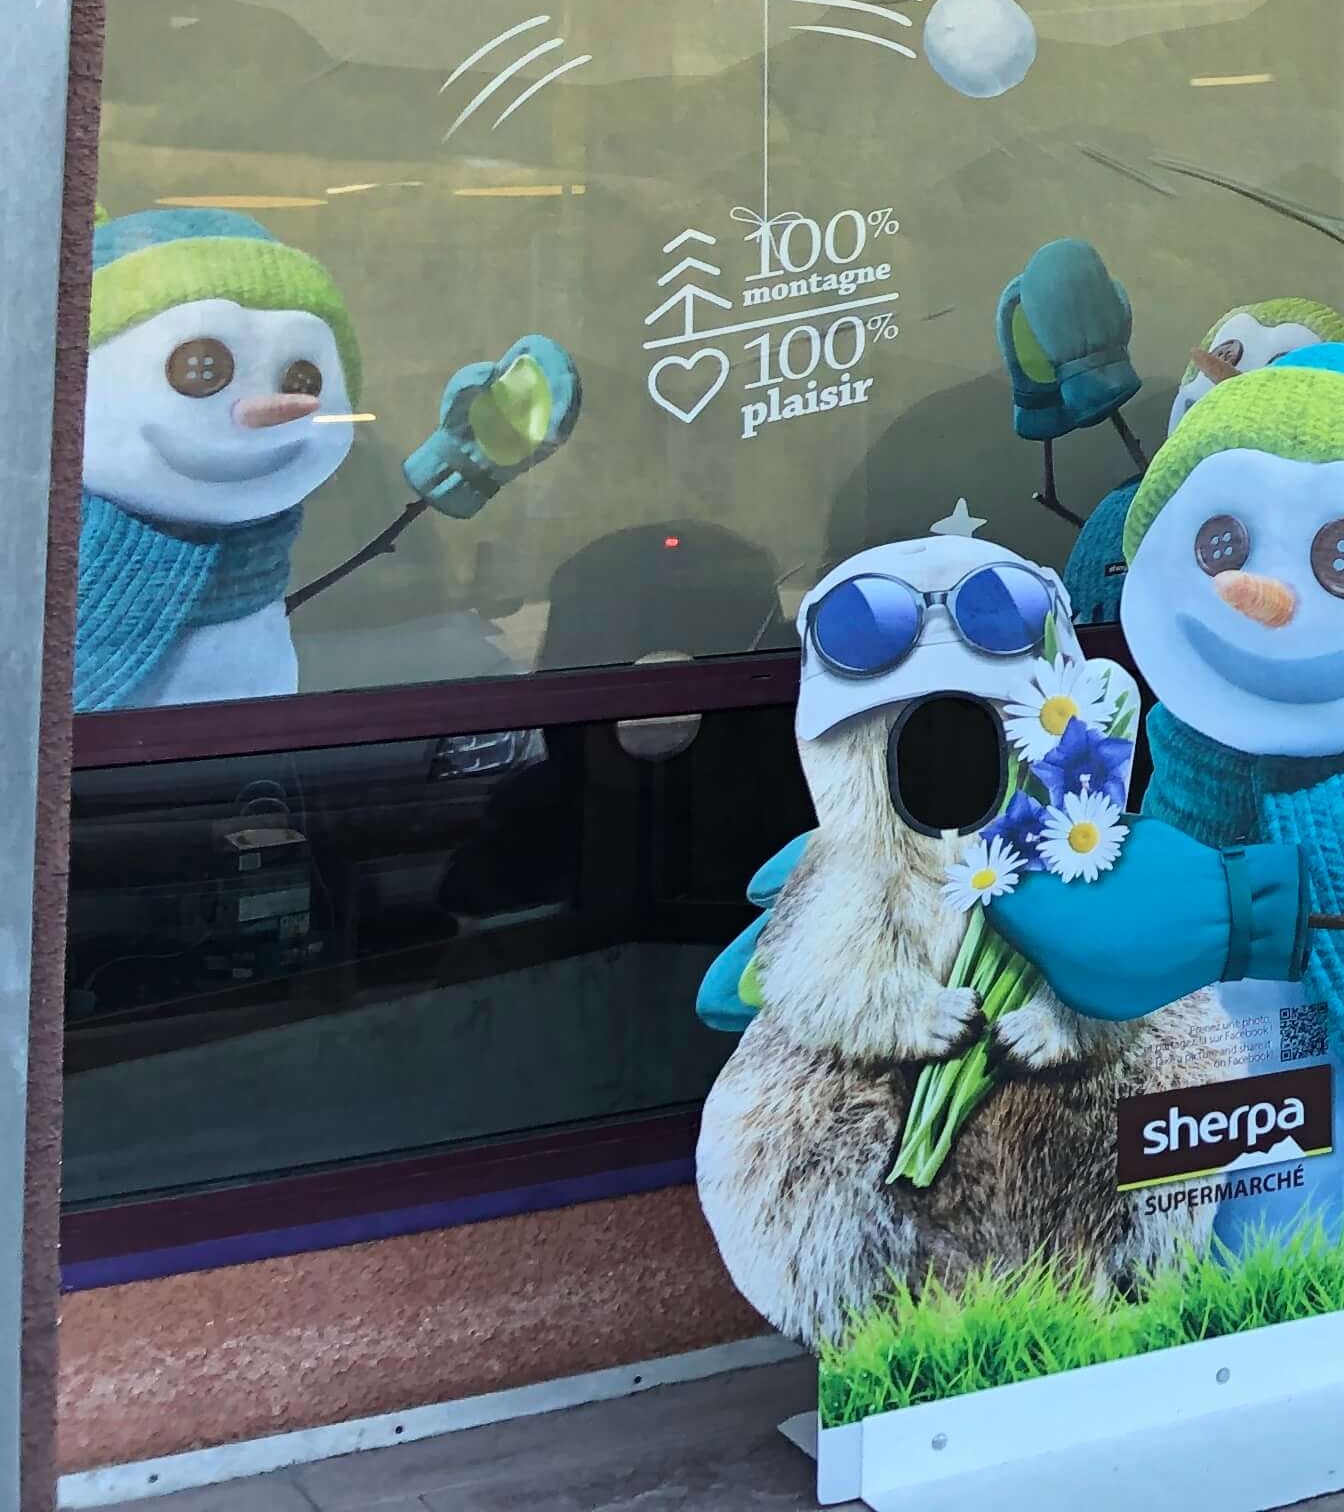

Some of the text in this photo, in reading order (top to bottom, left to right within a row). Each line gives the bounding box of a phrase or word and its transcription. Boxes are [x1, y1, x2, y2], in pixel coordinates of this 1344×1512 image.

[743, 207, 900, 282] 100%
[741, 262, 892, 307] montagne
[743, 313, 900, 390] 100%
[740, 372, 874, 439] plaisir
[1143, 1097, 1305, 1155] sherpa
[1144, 1164, 1305, 1217] SUPERMARCHÉ
